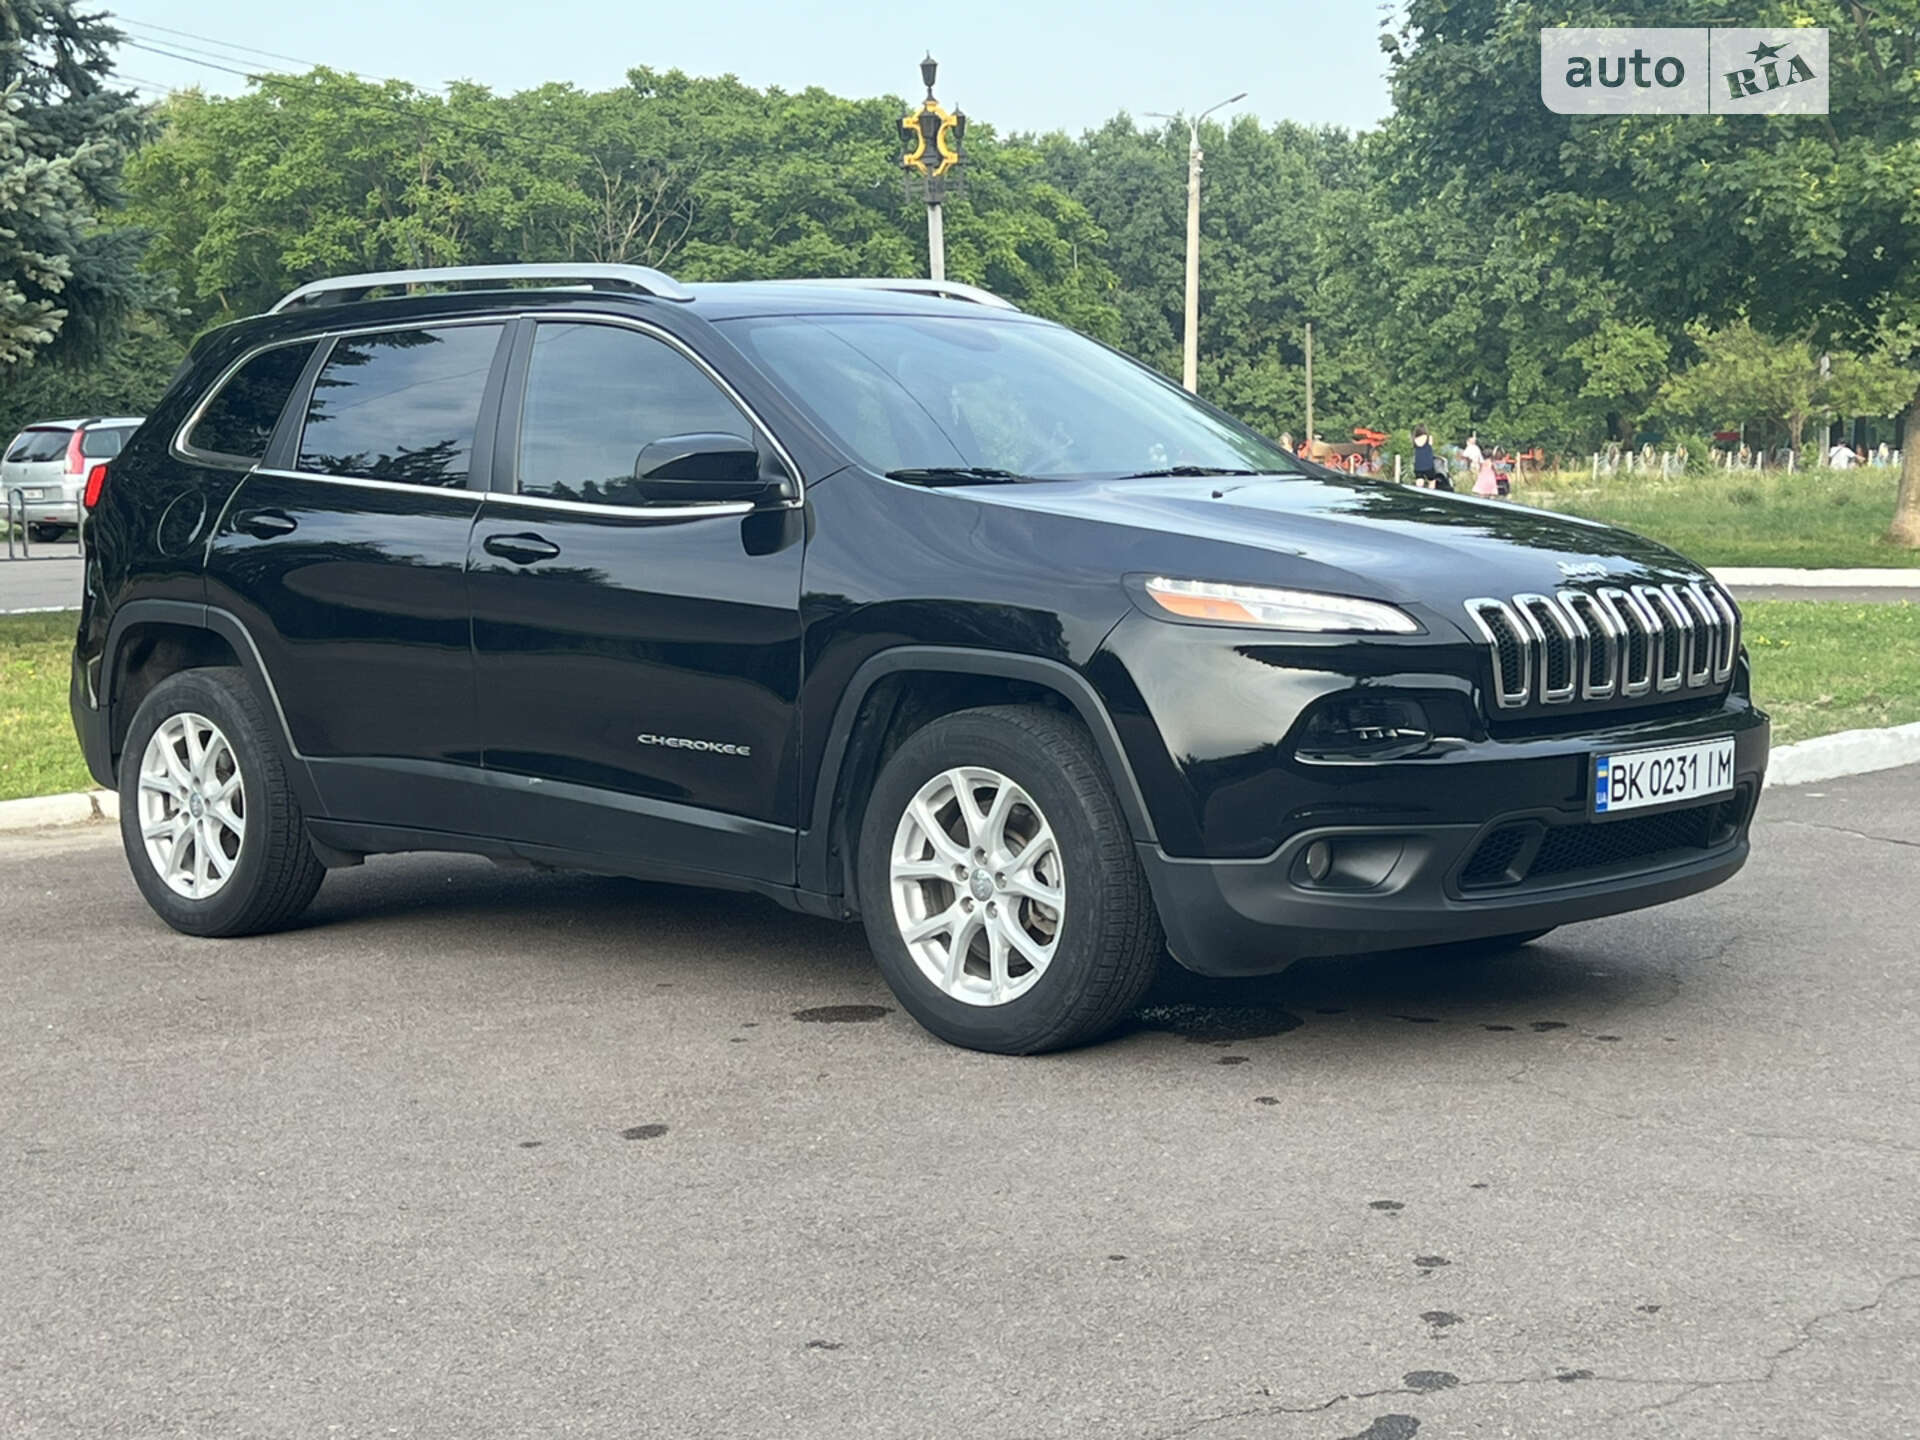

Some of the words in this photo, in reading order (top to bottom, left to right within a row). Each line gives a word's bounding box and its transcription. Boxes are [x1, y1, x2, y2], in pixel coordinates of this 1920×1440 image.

[637, 734, 751, 756] CHEROKEE
[1611, 761, 1645, 802] BK
[1649, 753, 1699, 797] 0231
[1707, 748, 1733, 788] IM
